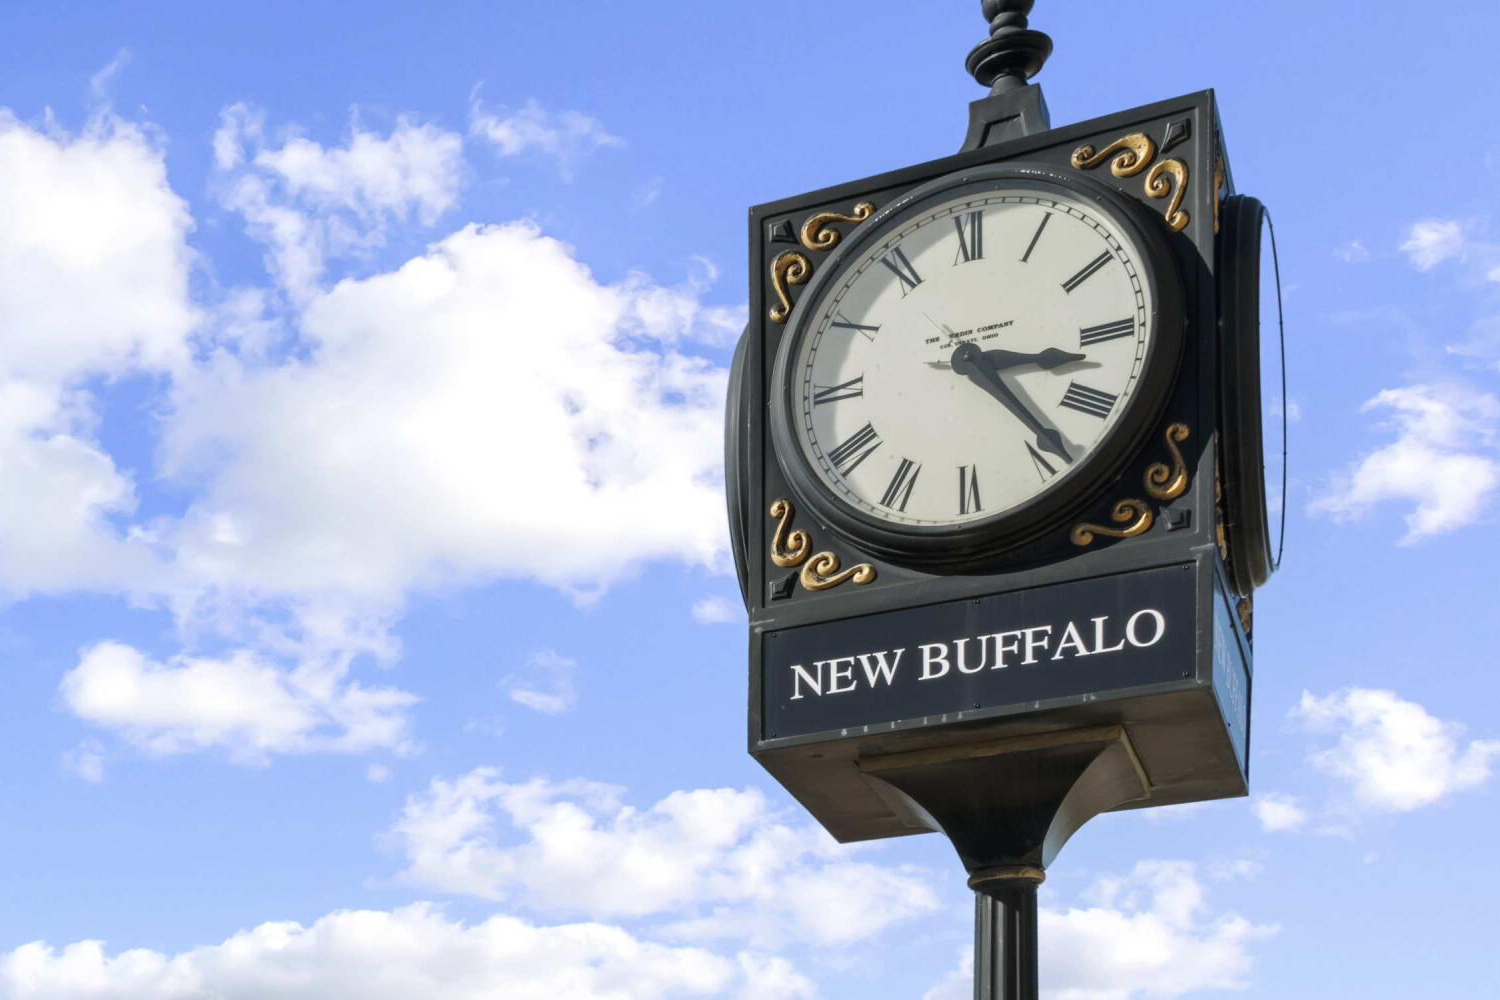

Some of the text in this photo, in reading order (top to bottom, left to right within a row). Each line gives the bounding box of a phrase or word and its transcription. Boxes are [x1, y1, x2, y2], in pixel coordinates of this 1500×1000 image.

[952, 210, 985, 266] XII
[877, 246, 926, 299] XI
[1060, 248, 1115, 295] II
[829, 311, 882, 342] X
[949, 329, 973, 339] ERDIN
[977, 320, 1013, 333] COMPANY
[982, 333, 998, 341] OHIO
[1080, 314, 1135, 350] III
[814, 371, 864, 409] IX
[827, 420, 883, 480] VIII
[1024, 440, 1059, 484] V
[877, 456, 922, 513] VII
[956, 464, 985, 516] VI
[790, 609, 1166, 700] NEW BUFFALO
